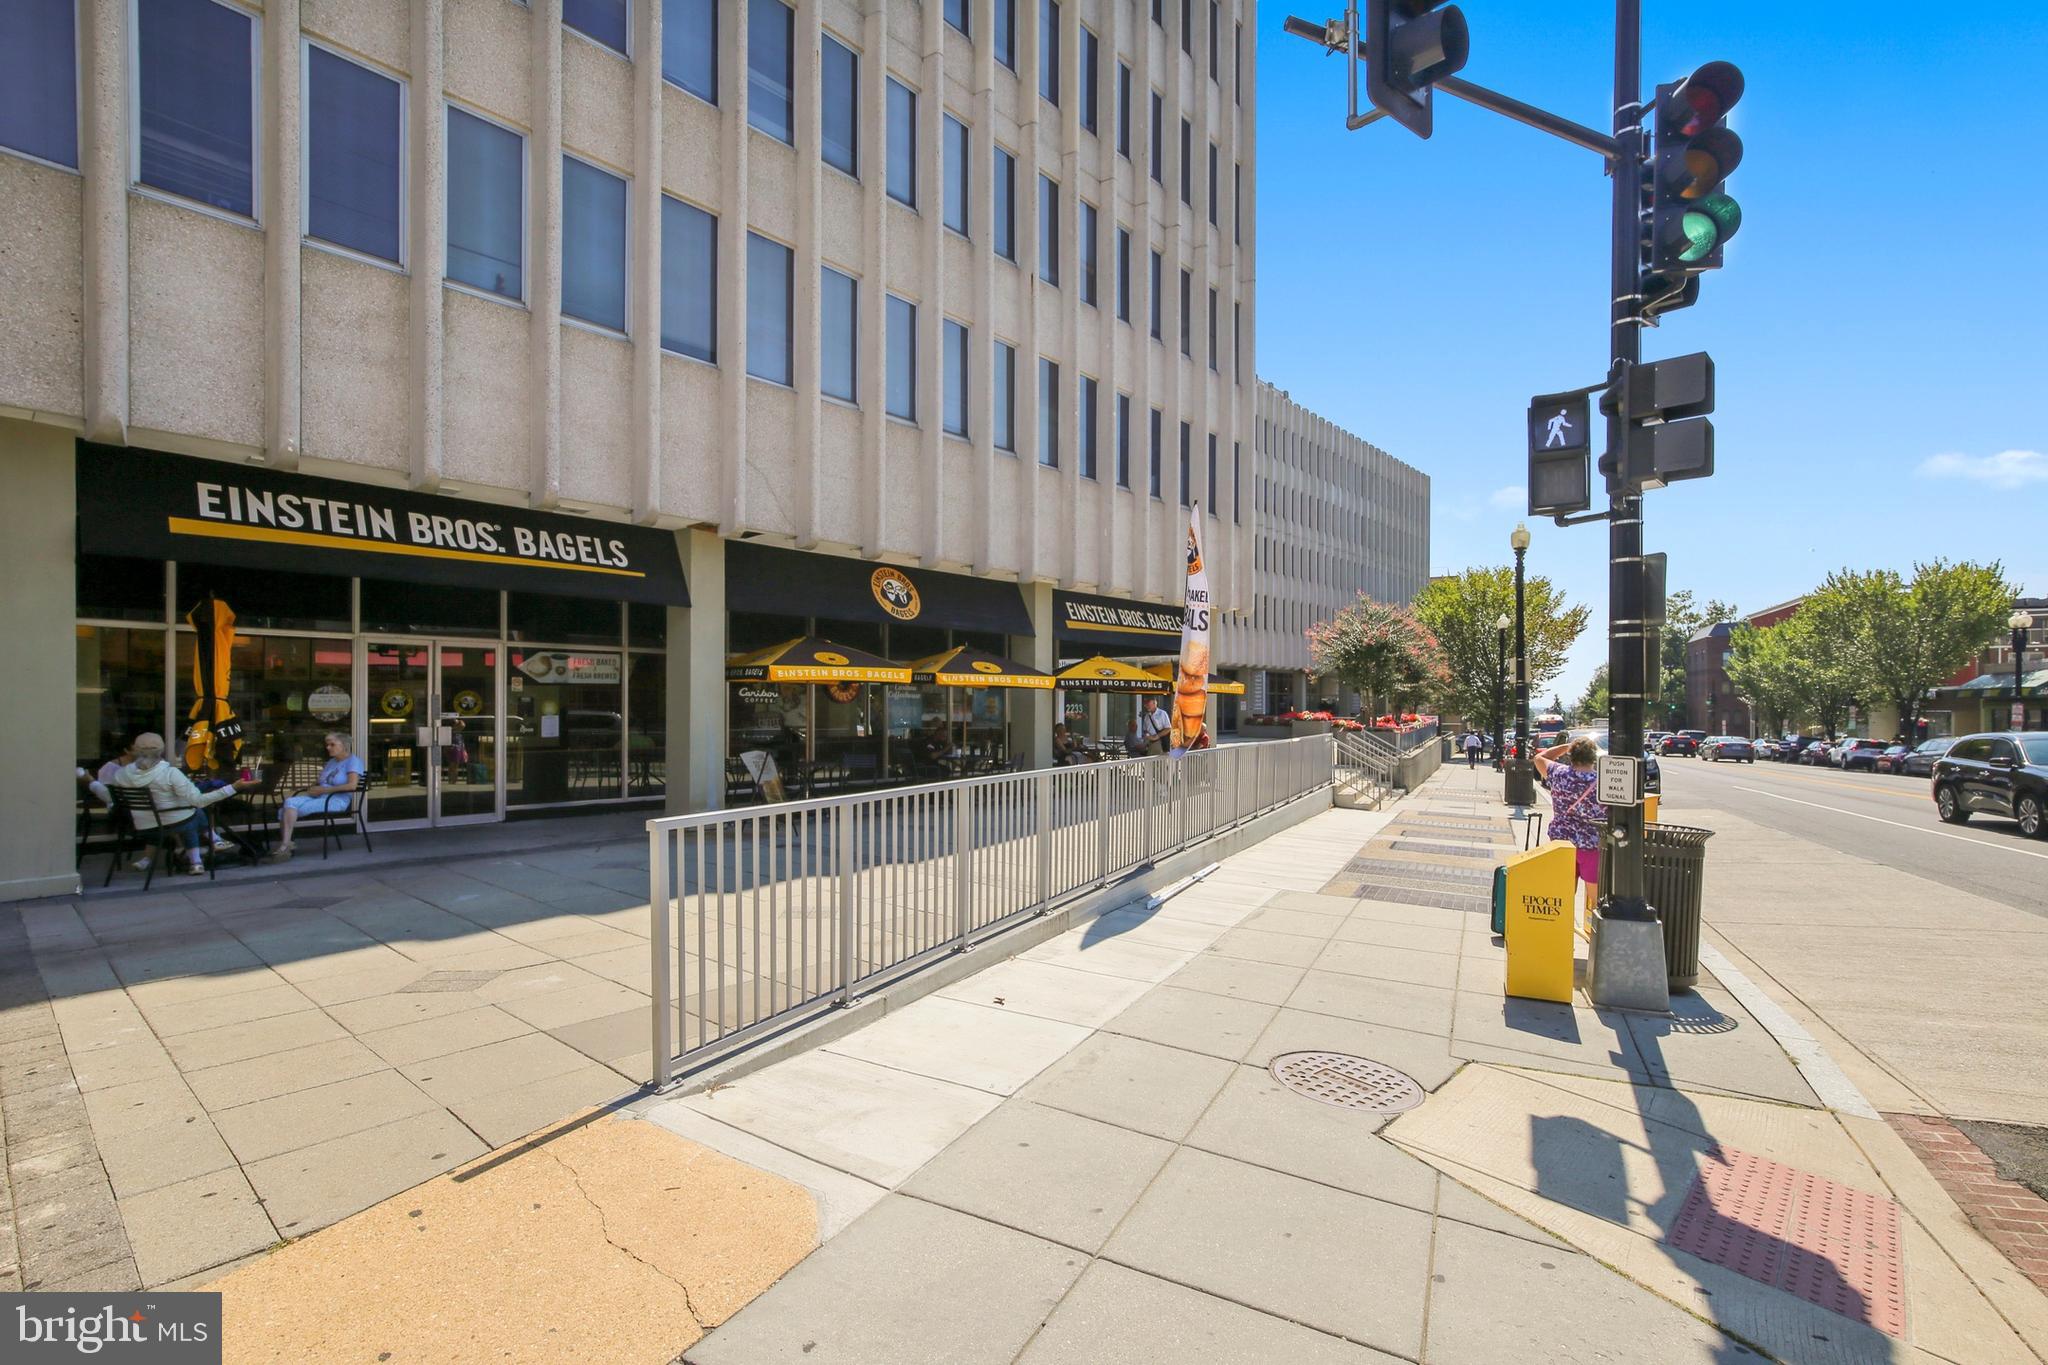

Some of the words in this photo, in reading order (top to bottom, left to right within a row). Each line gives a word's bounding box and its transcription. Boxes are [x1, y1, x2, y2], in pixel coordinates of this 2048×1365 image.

[196, 481, 397, 542] EINSTEIN
[513, 526, 629, 568] BAGELS
[890, 606, 915, 618] BAGELS
[1065, 601, 1120, 625] EINSTEIN
[1147, 612, 1184, 632] BAGELS
[777, 669, 829, 678] EINSTEIN
[866, 670, 906, 680] BAGELS
[942, 674, 986, 683] EINSTEIN
[1017, 677, 1051, 686] BAGELS
[1130, 681, 1163, 689] BAGELS
[738, 687, 779, 698] Caribou
[1065, 703, 1084, 714] 2233
[1522, 895, 1562, 907] EPOCH
[1526, 905, 1561, 916] TIMES
